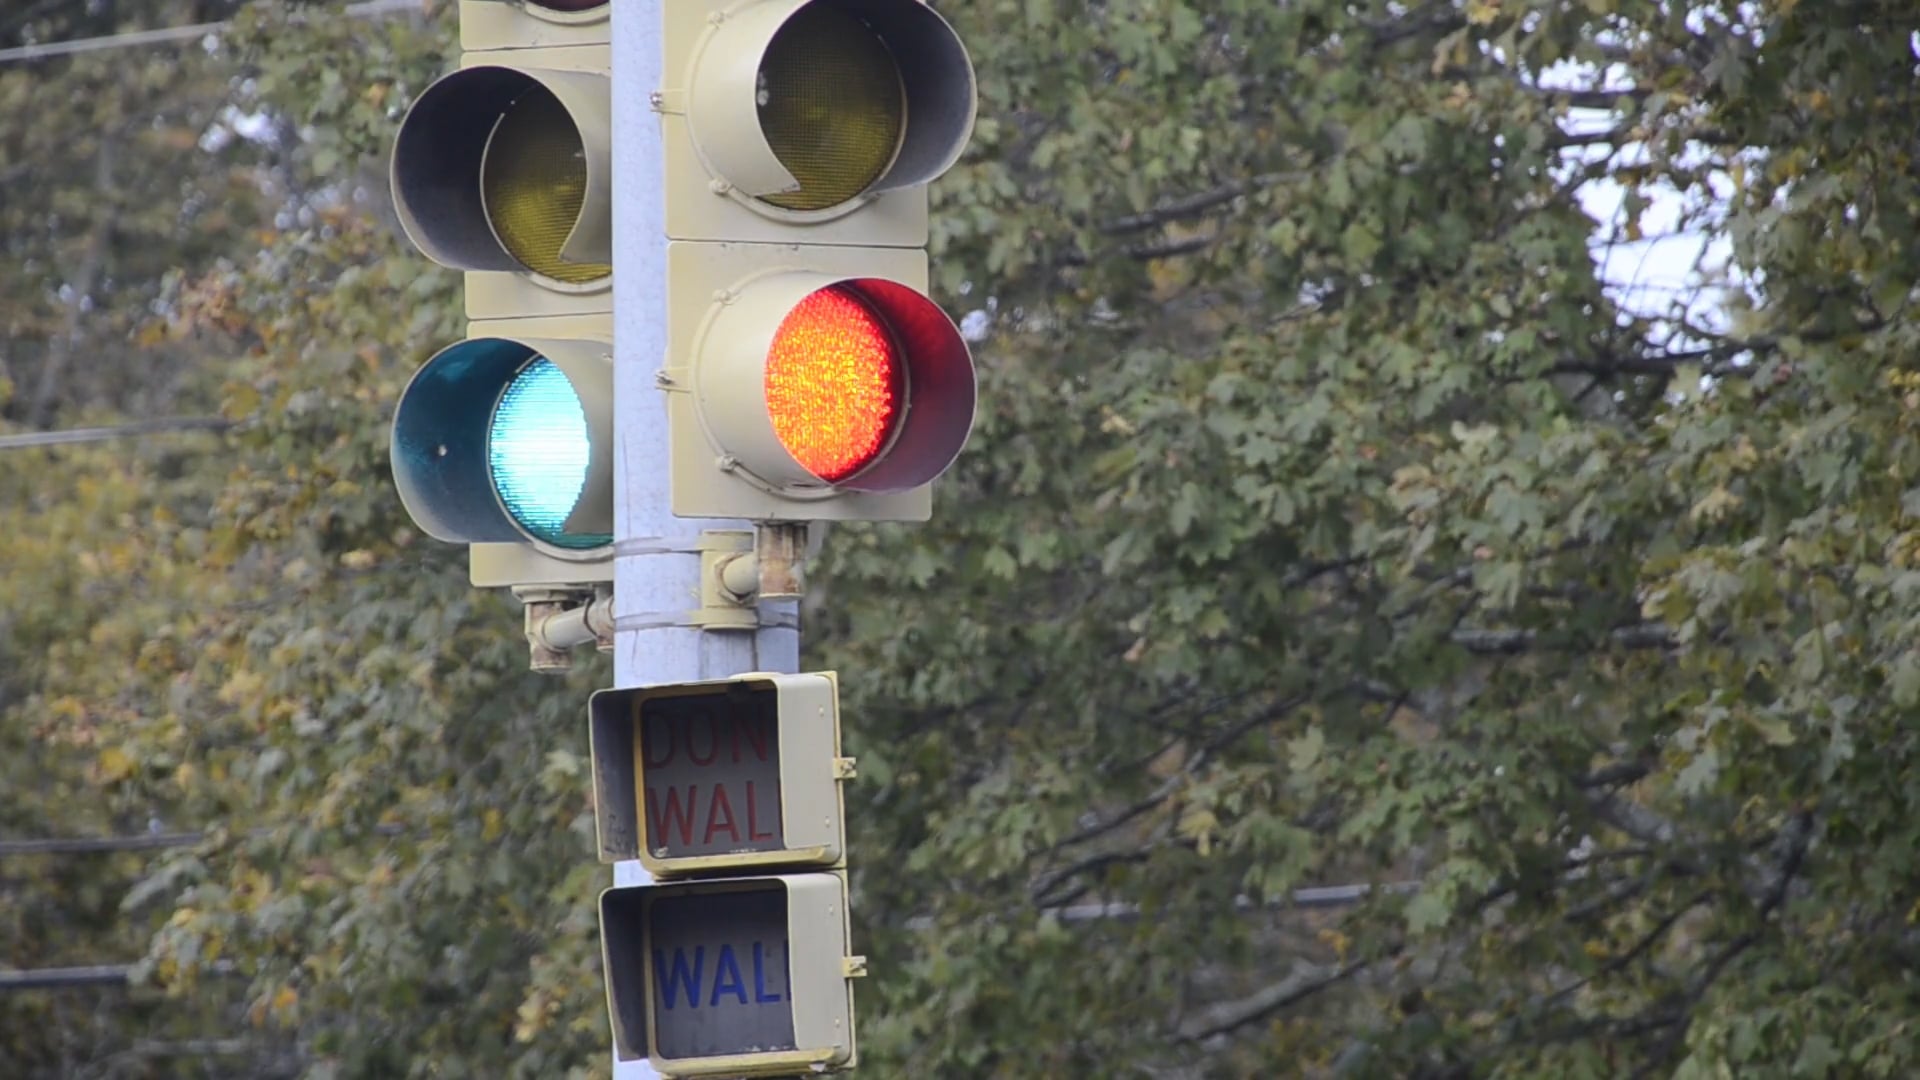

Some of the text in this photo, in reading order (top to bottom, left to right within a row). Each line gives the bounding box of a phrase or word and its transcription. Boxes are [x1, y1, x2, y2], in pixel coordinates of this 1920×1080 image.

[643, 704, 769, 769] DON
[645, 779, 783, 848] WAL
[654, 939, 792, 1010] WAL
